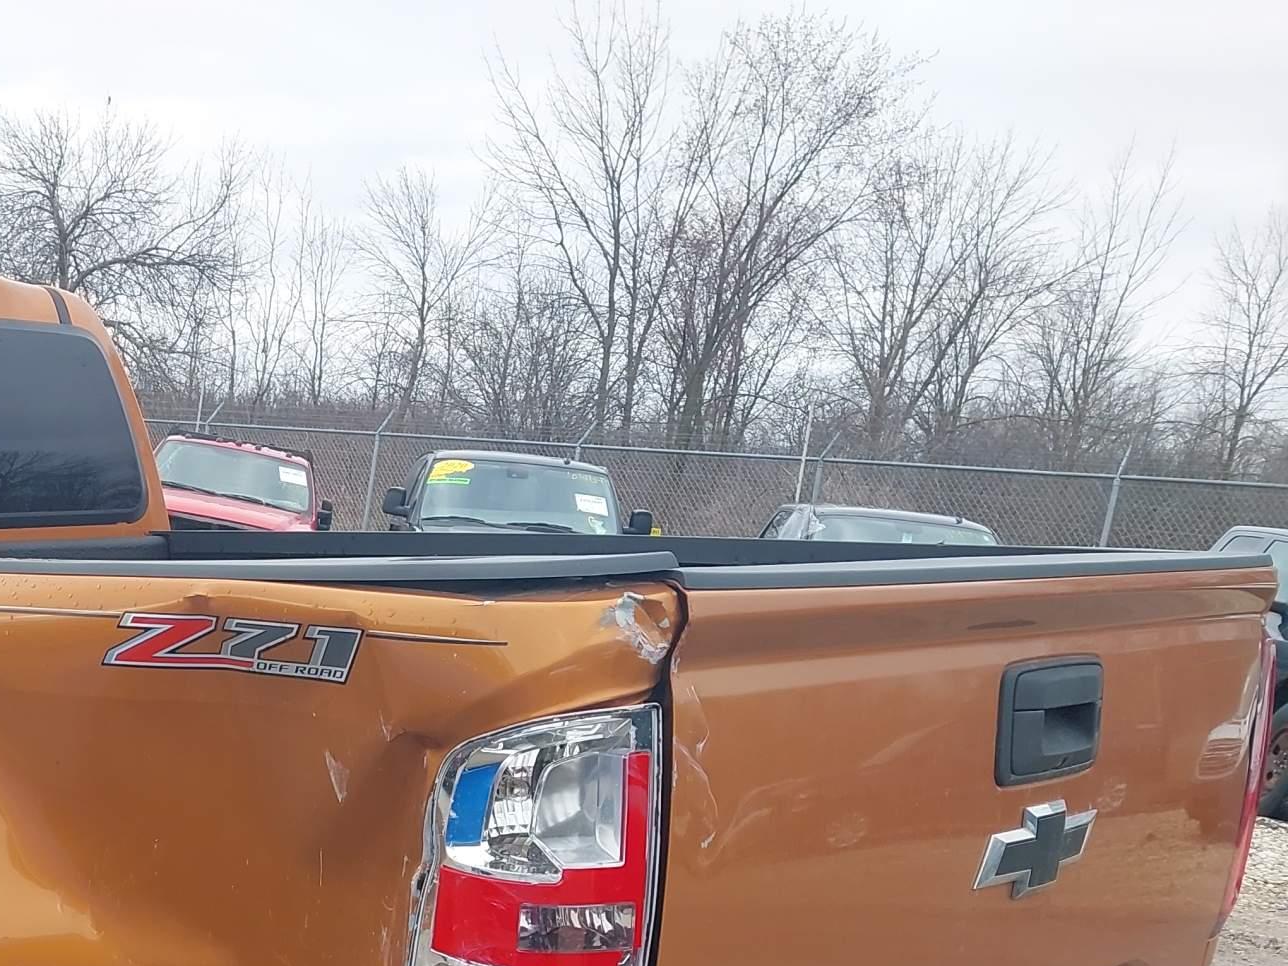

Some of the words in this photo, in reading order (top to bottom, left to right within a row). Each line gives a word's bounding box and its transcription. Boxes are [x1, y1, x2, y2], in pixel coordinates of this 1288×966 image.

[101, 611, 365, 675] Z71
[255, 661, 291, 674] OFF
[294, 664, 345, 680] ROAD
